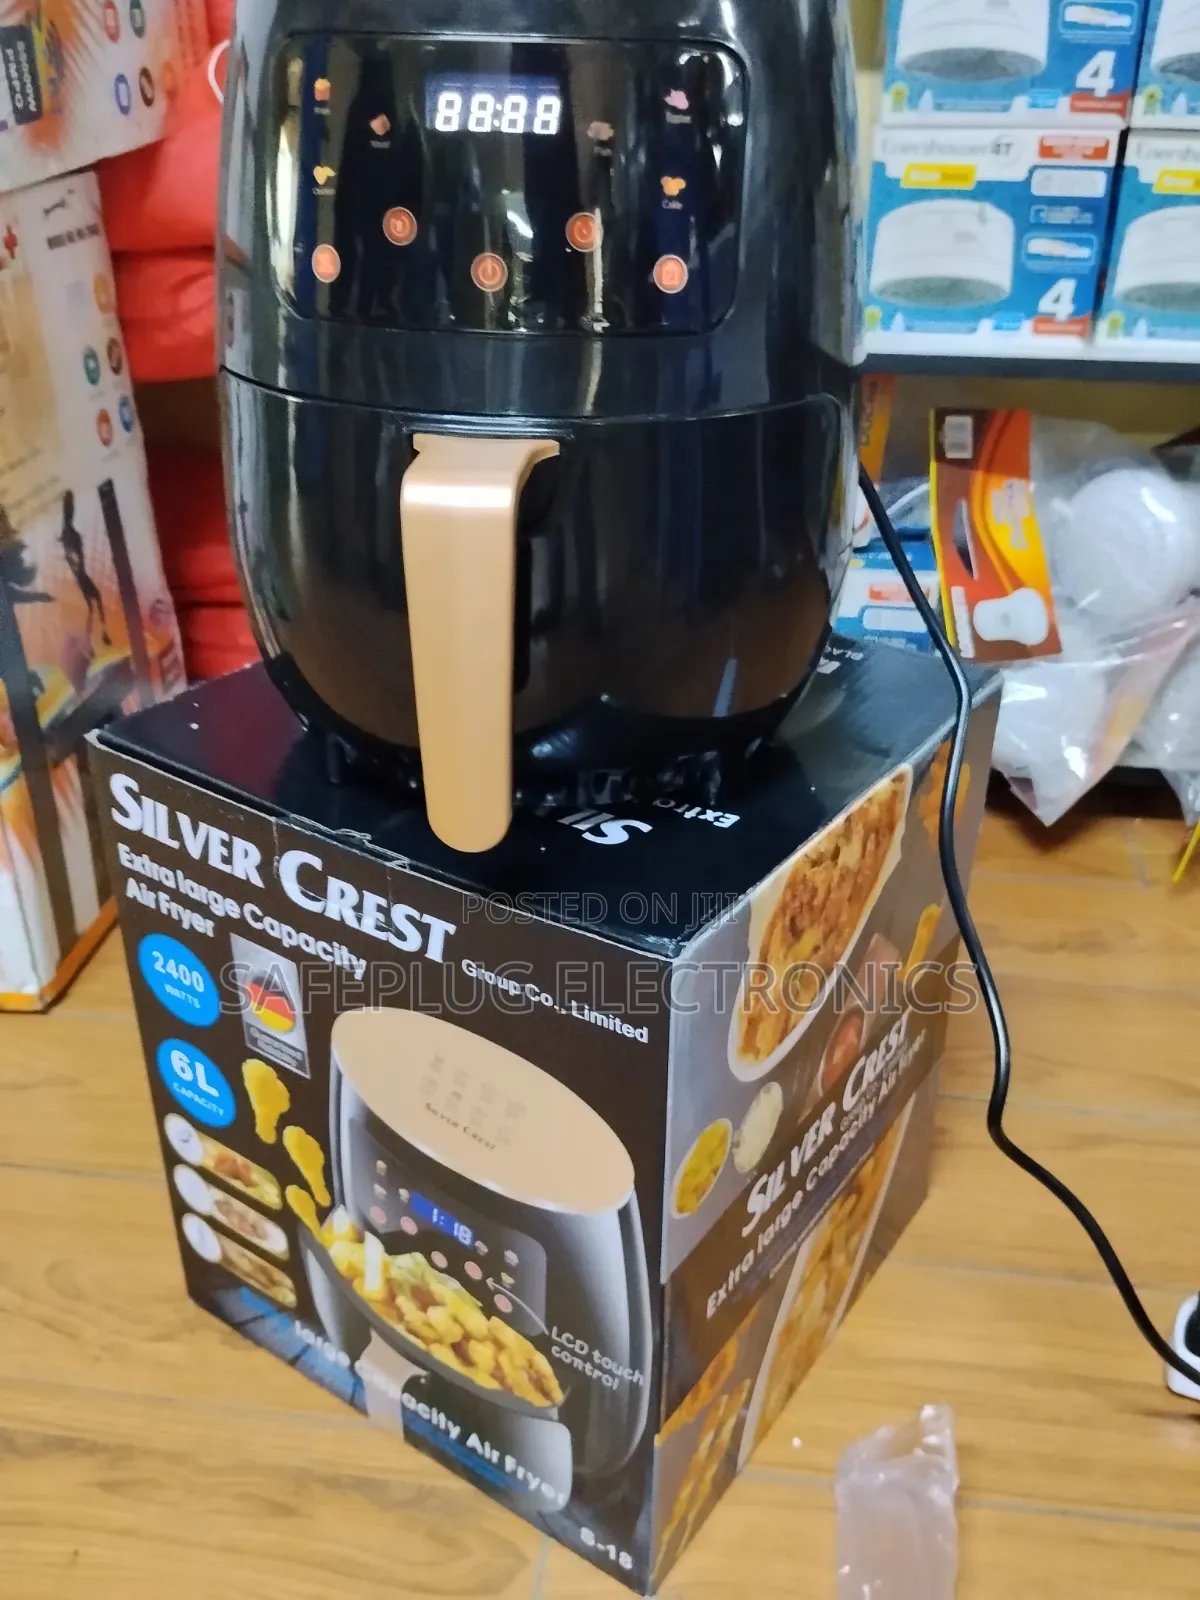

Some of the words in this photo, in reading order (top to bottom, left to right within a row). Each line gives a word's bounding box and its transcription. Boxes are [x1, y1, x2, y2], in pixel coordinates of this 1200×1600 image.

[1075, 50, 1116, 98] 4
[1037, 278, 1077, 321] 4
[117, 842, 177, 889] Extra
[176, 869, 241, 919] large
[243, 902, 367, 980] Capacity
[126, 877, 156, 910] Air
[158, 891, 215, 938] Fryer
[152, 950, 204, 993] 2400
[461, 958, 521, 996] Group
[571, 1000, 649, 1043] Limited
[170, 1049, 220, 1098] 6L
[551, 1326, 589, 1355] LCD
[592, 1349, 645, 1387] touch
[551, 1345, 619, 1391] control
[466, 1432, 500, 1465] Air
